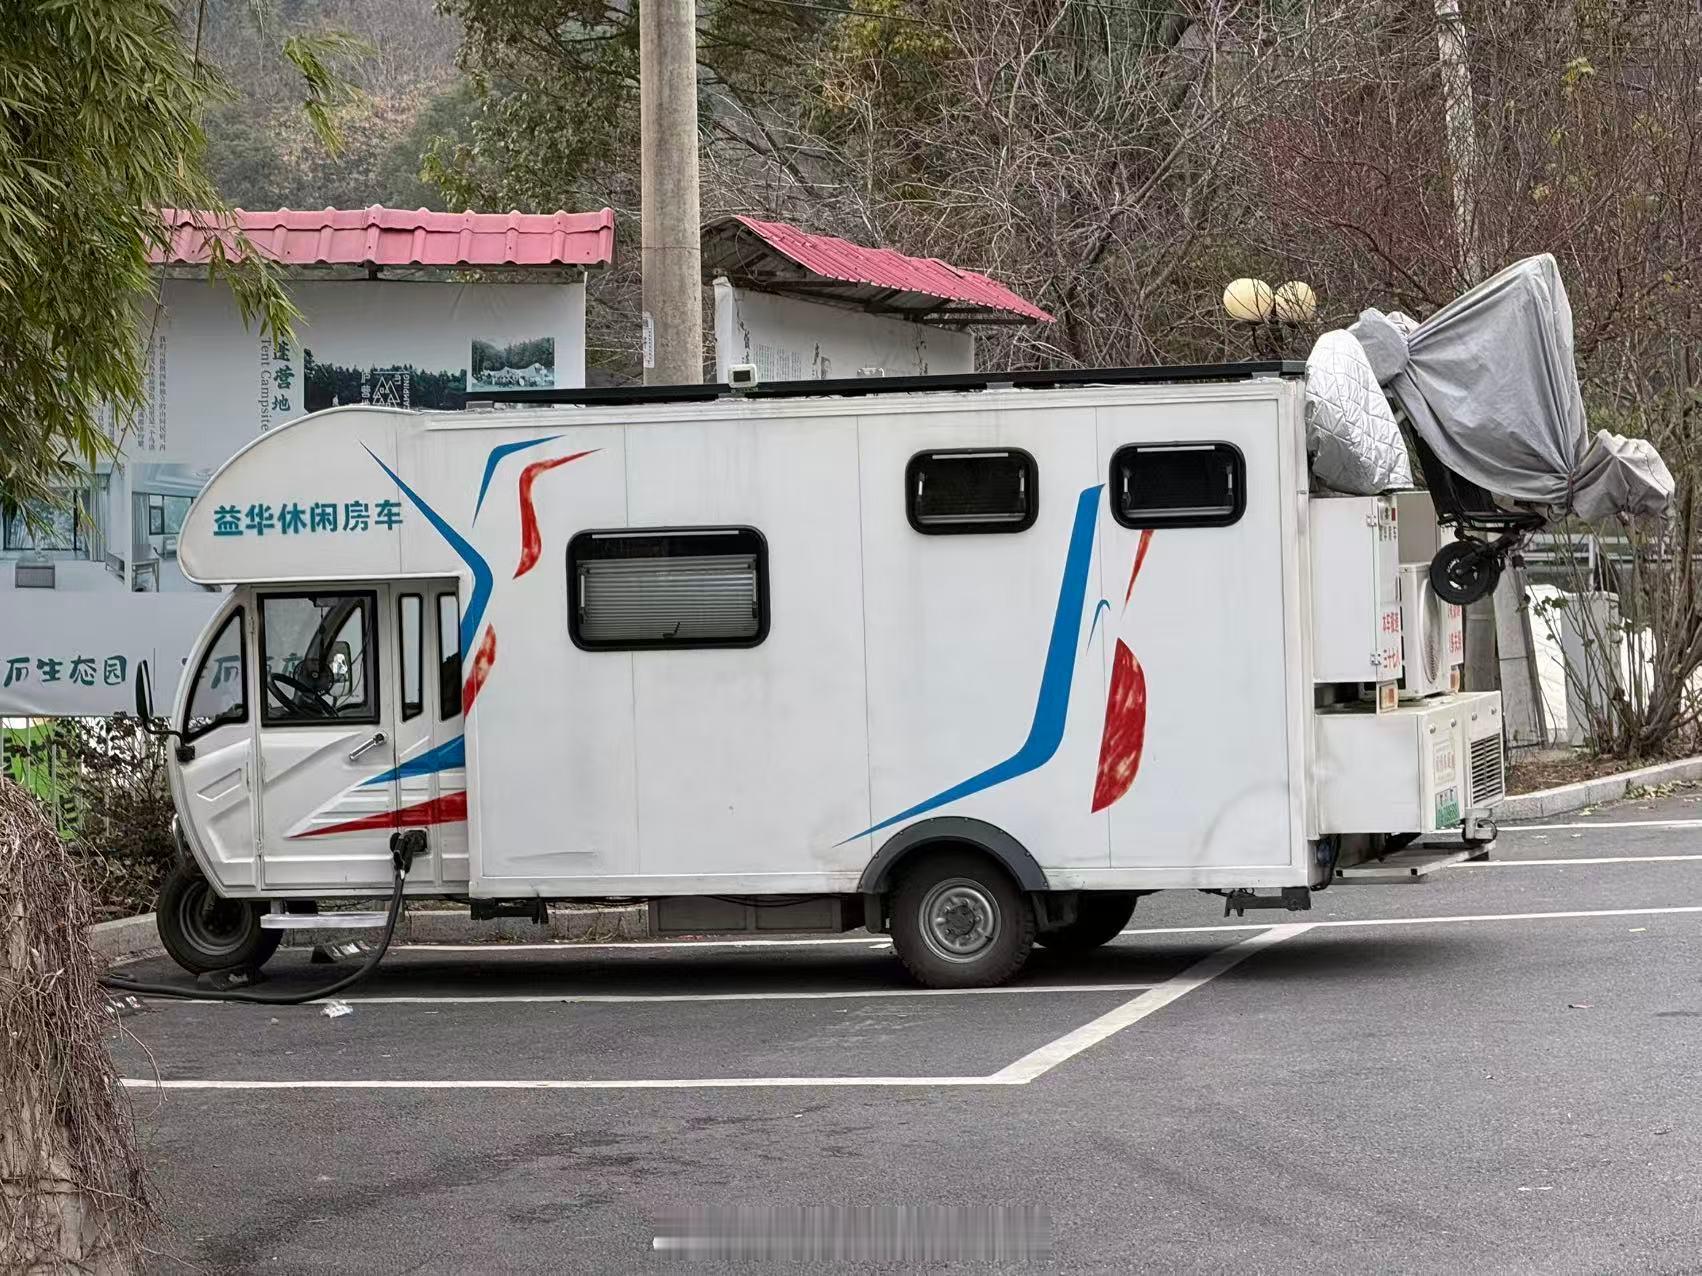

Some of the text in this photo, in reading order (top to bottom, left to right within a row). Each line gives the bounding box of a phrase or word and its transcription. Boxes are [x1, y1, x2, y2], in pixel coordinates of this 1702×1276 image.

[258, 337, 272, 431] Tent Campsite
[213, 499, 403, 536] 益华休闲房车
